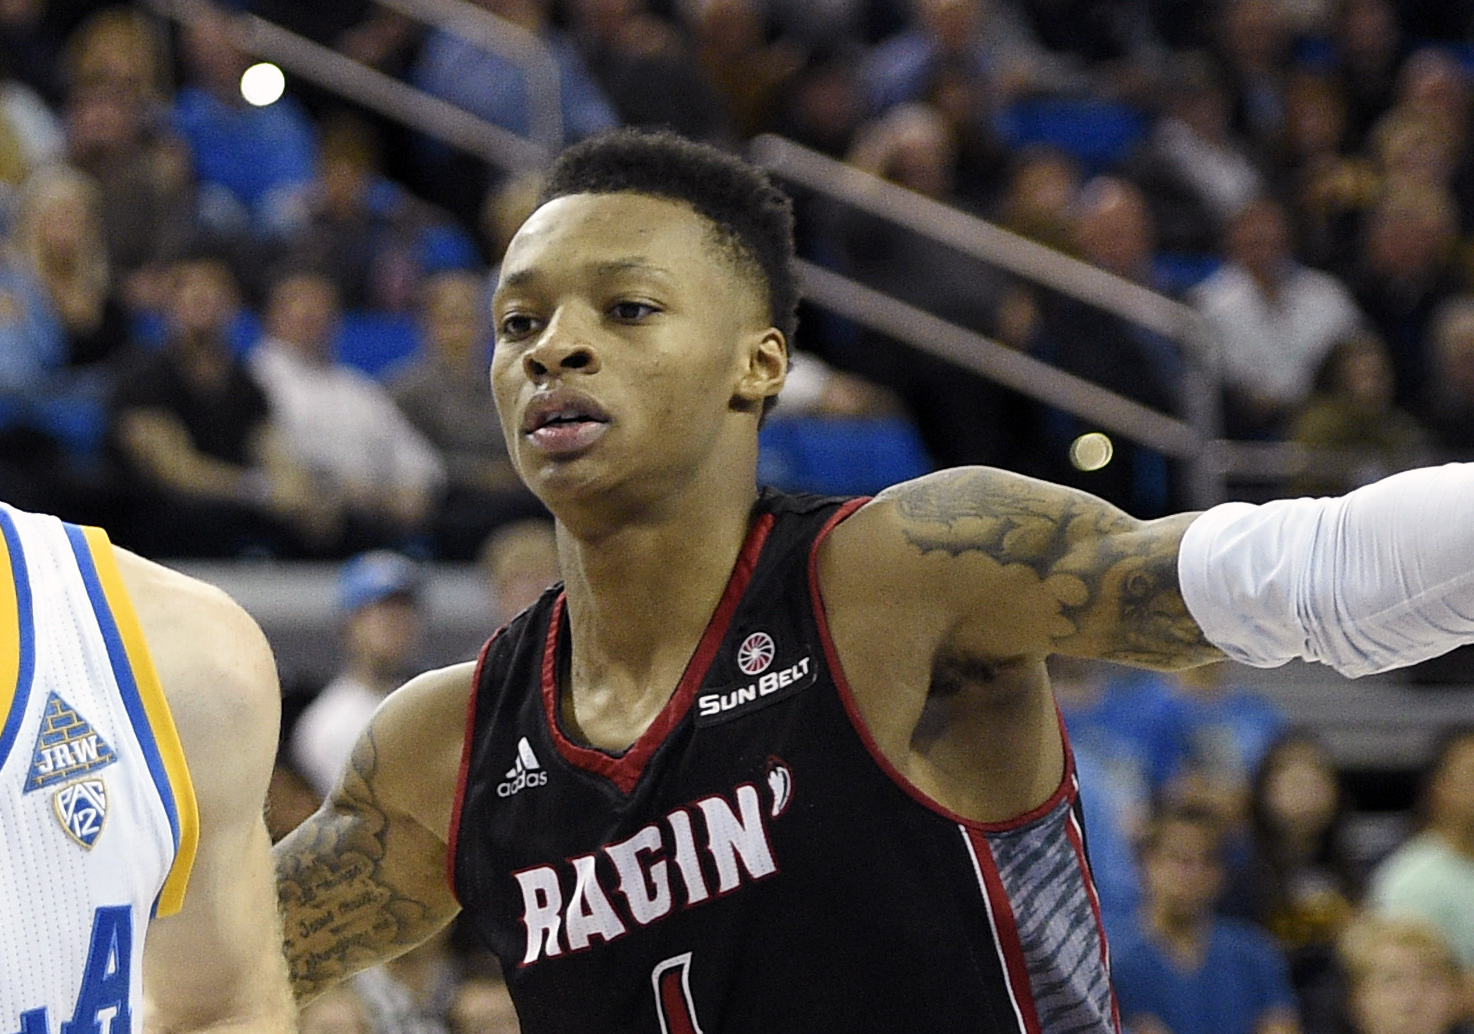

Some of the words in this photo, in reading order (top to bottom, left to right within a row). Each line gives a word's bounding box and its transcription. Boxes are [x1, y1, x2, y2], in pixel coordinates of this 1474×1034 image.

[698, 684, 757, 717] SUN
[758, 656, 810, 697] BELT
[38, 735, 98, 774] JRW
[496, 769, 548, 798] addas
[57, 781, 106, 827] PAC
[73, 807, 101, 838] 12
